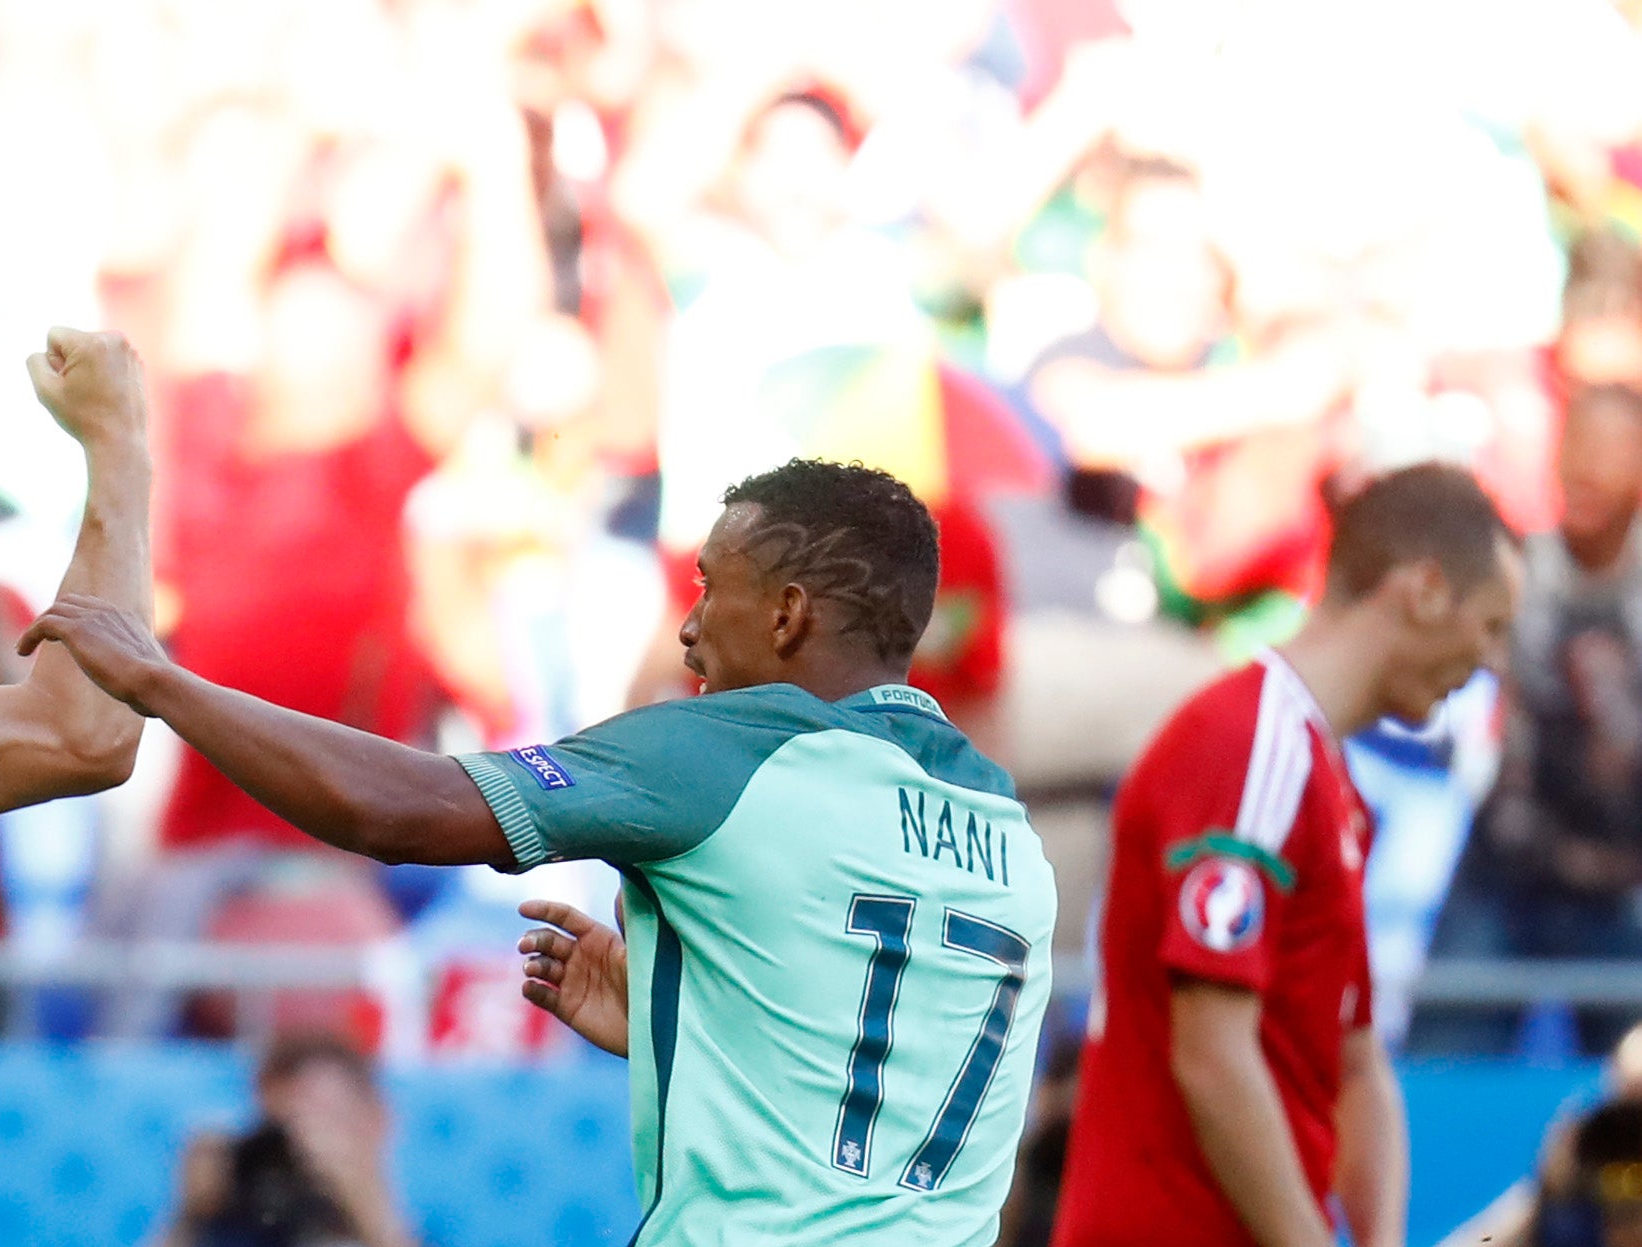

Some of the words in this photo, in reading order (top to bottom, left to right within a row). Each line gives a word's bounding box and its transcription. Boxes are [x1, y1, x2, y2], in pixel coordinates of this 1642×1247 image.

[519, 748, 568, 787] ESPECT
[898, 787, 1009, 888] NANI
[832, 892, 1032, 1193] 17
